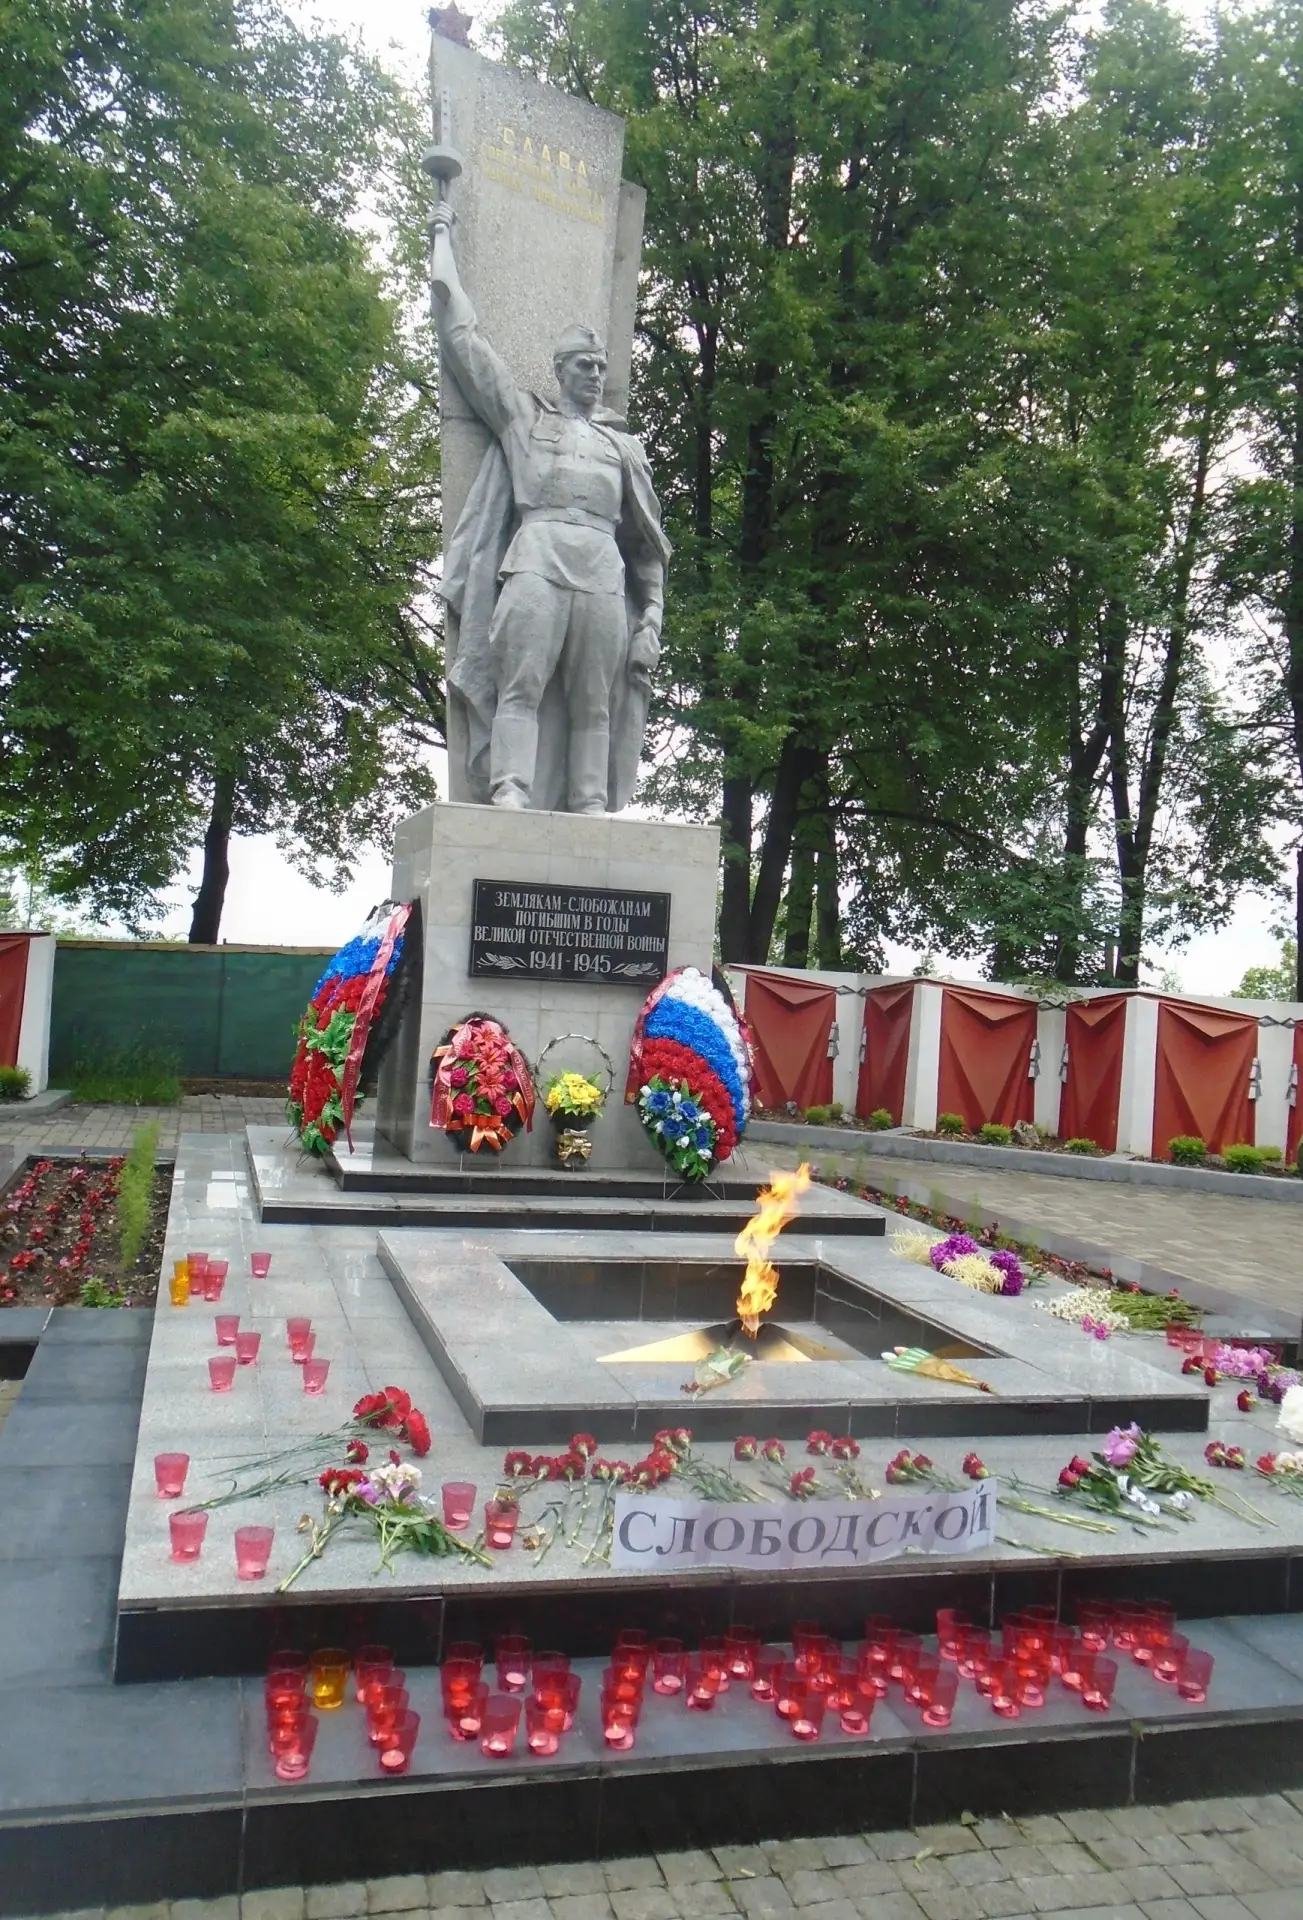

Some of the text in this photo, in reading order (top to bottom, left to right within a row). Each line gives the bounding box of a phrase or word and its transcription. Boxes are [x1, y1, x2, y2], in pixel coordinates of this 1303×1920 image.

[515, 910, 629, 933] ПОГИБШИМ В ГОДЫ
[474, 926, 665, 953] ВЕЛИКОЙ ОТЕЧЕСТВЕННОЙ ВОЙНЫ
[529, 950, 563, 970] 1941
[573, 953, 611, 973] 1945
[618, 1486, 992, 1559] СЛОБОДСКОЙ
